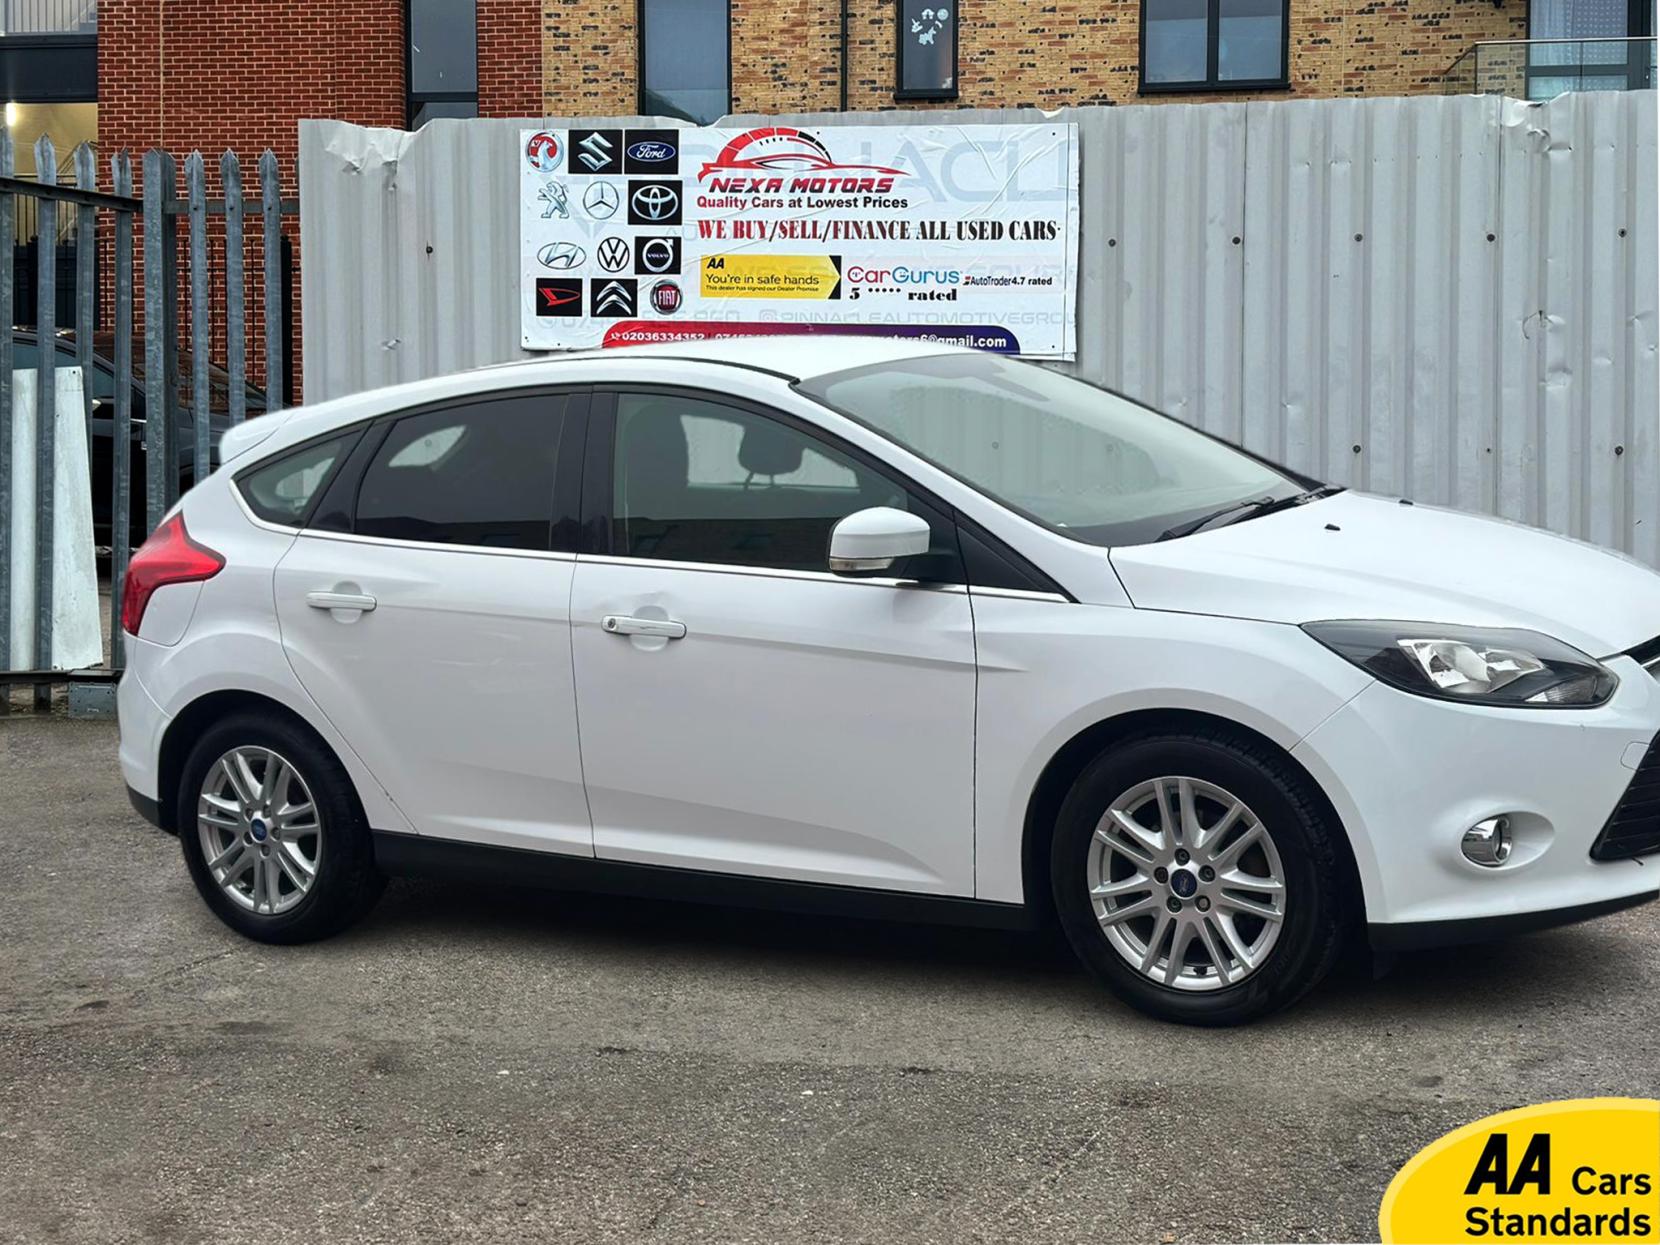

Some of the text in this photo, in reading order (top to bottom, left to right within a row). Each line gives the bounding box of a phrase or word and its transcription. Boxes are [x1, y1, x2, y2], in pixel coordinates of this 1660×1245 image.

[636, 144, 666, 159] Ford
[709, 177, 894, 193] NEXA MOTORS
[697, 196, 908, 210] Quality Cars at Lowest Prices
[697, 220, 727, 239] WE
[733, 220, 910, 243] BUY/SELL/FINANCE
[916, 220, 950, 240] ALL
[957, 220, 1004, 240] USED
[706, 257, 725, 269] AA
[706, 274, 820, 285] You're in safe hands
[847, 266, 960, 283] CarGurus
[1028, 277, 1053, 286] rated
[658, 289, 677, 306] FIAT
[849, 287, 957, 301] 5 rated
